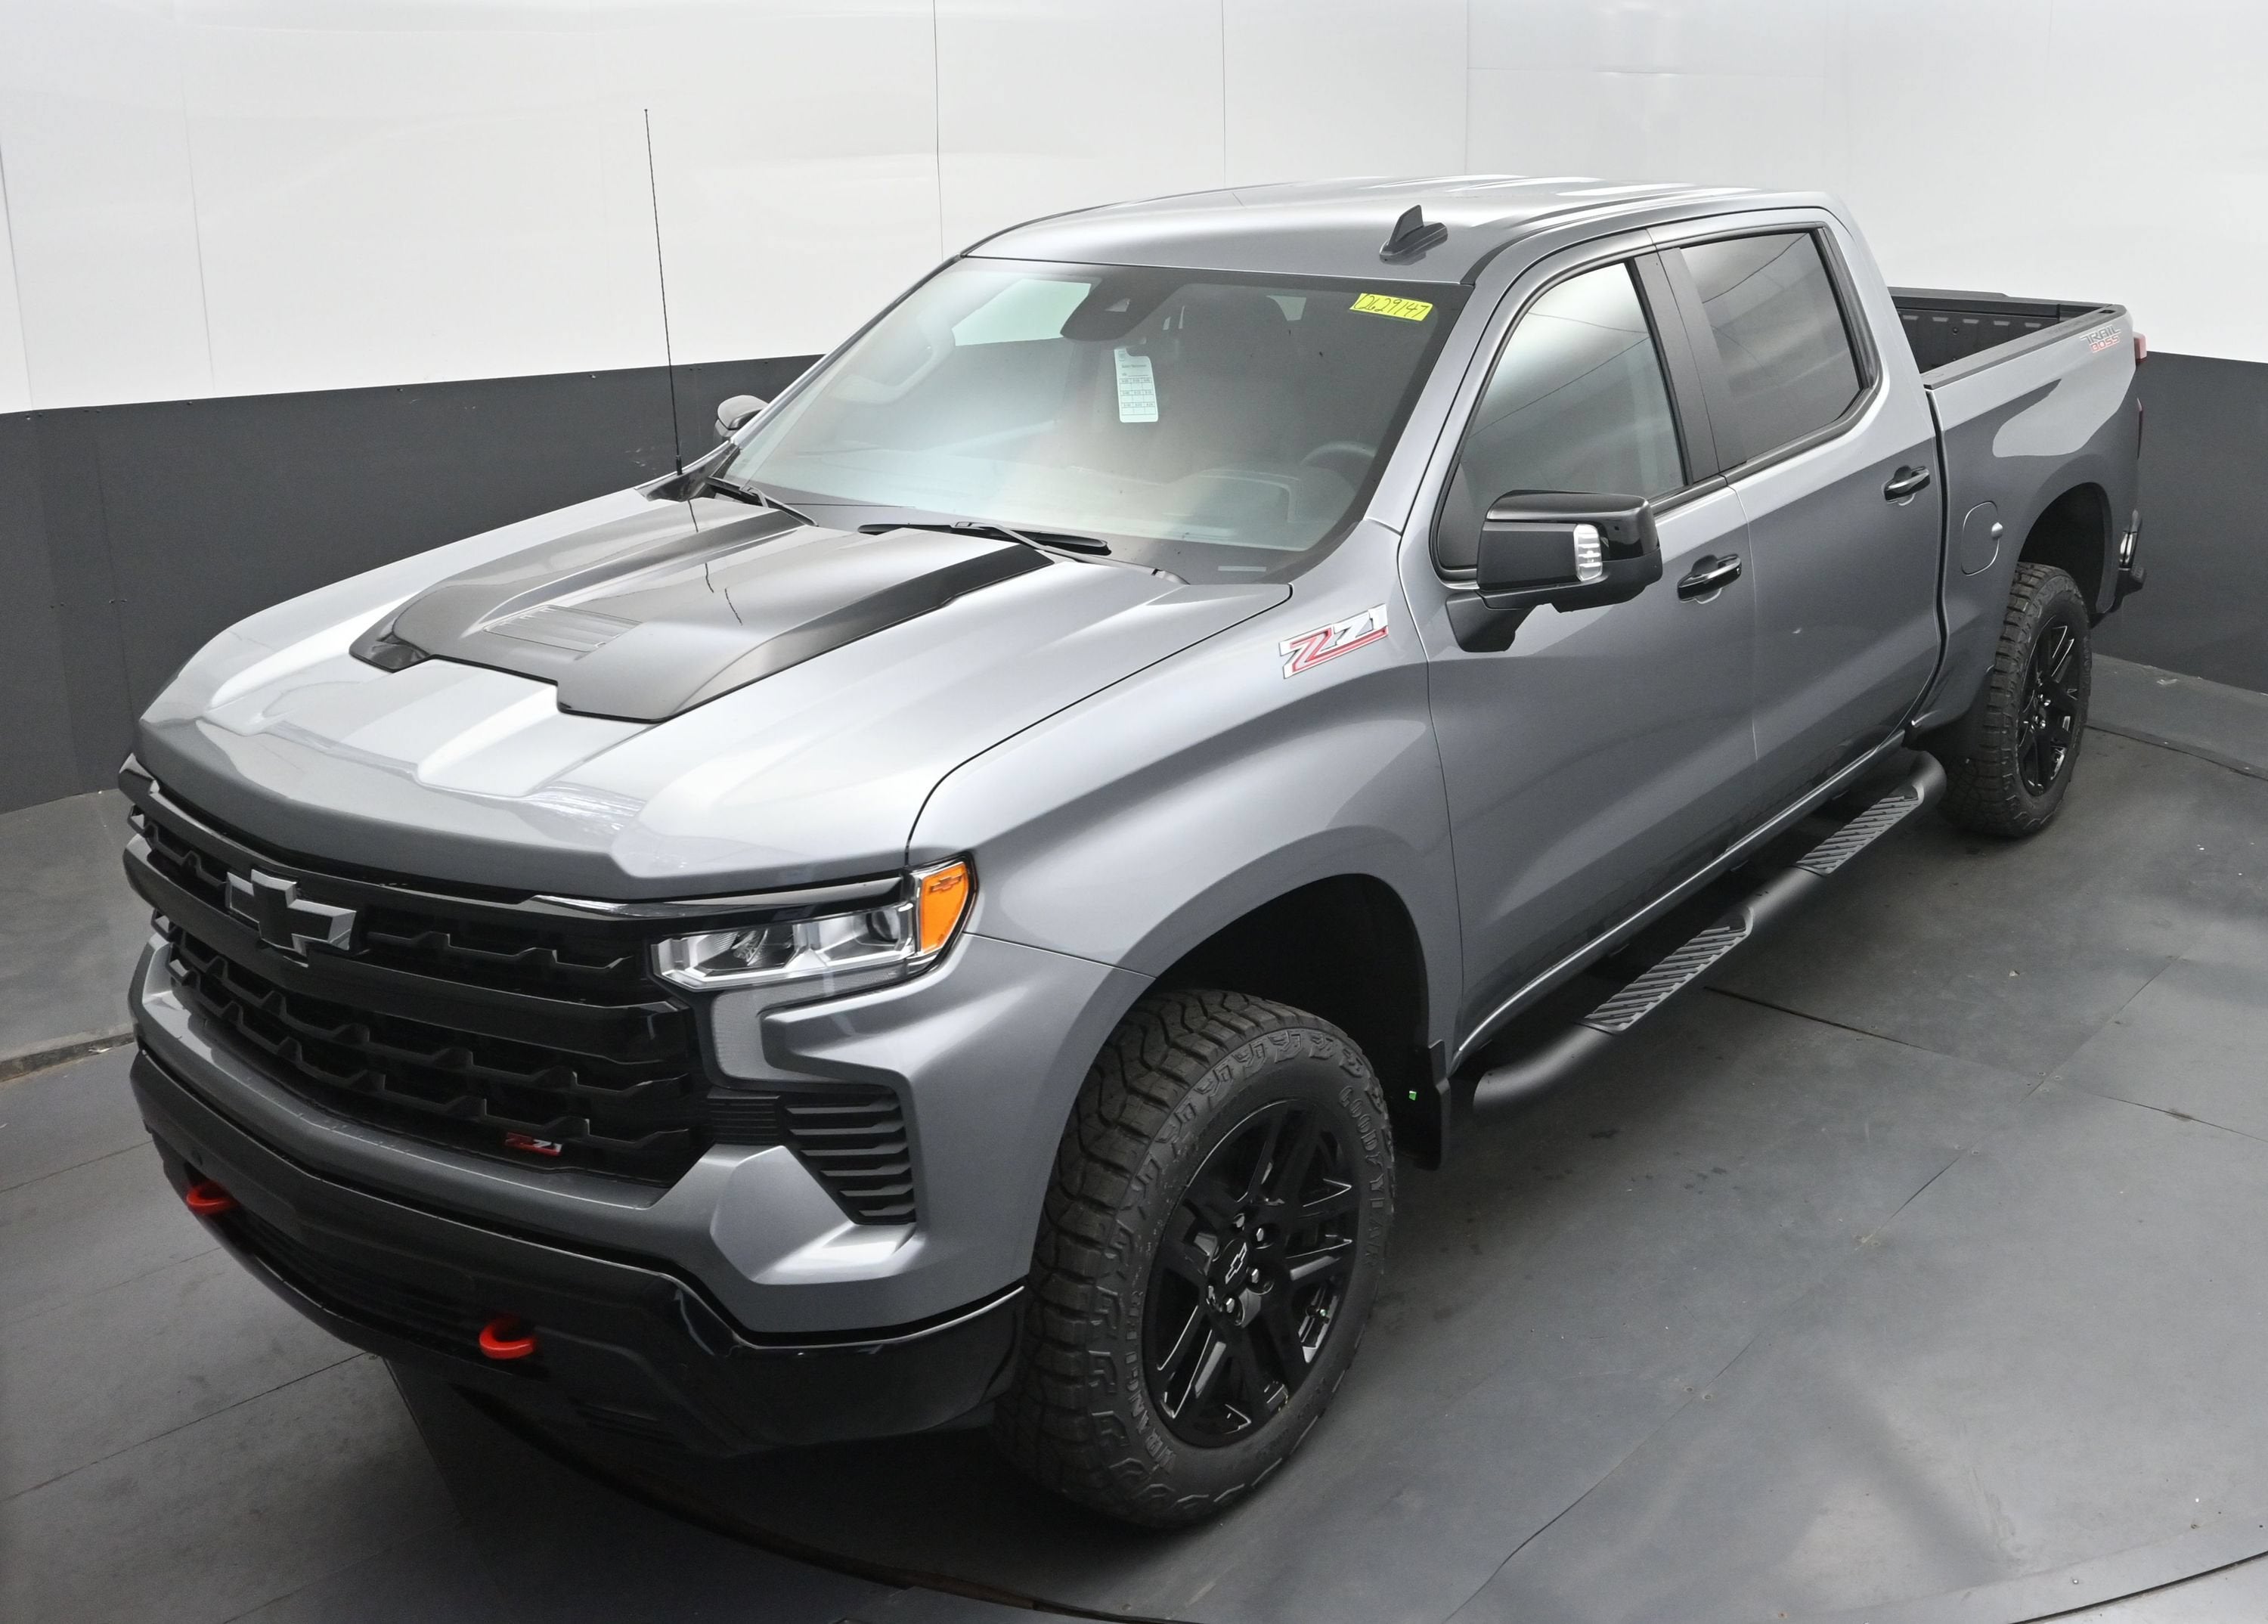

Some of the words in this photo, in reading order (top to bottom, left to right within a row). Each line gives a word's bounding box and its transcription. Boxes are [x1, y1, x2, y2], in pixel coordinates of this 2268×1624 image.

[2081, 325, 2121, 343] TRAIL
[2090, 336, 2120, 353] BOSS
[1278, 603, 1389, 679] Z71
[504, 1132, 563, 1157] Z71
[1339, 1086, 1385, 1267] GOODYEAR
